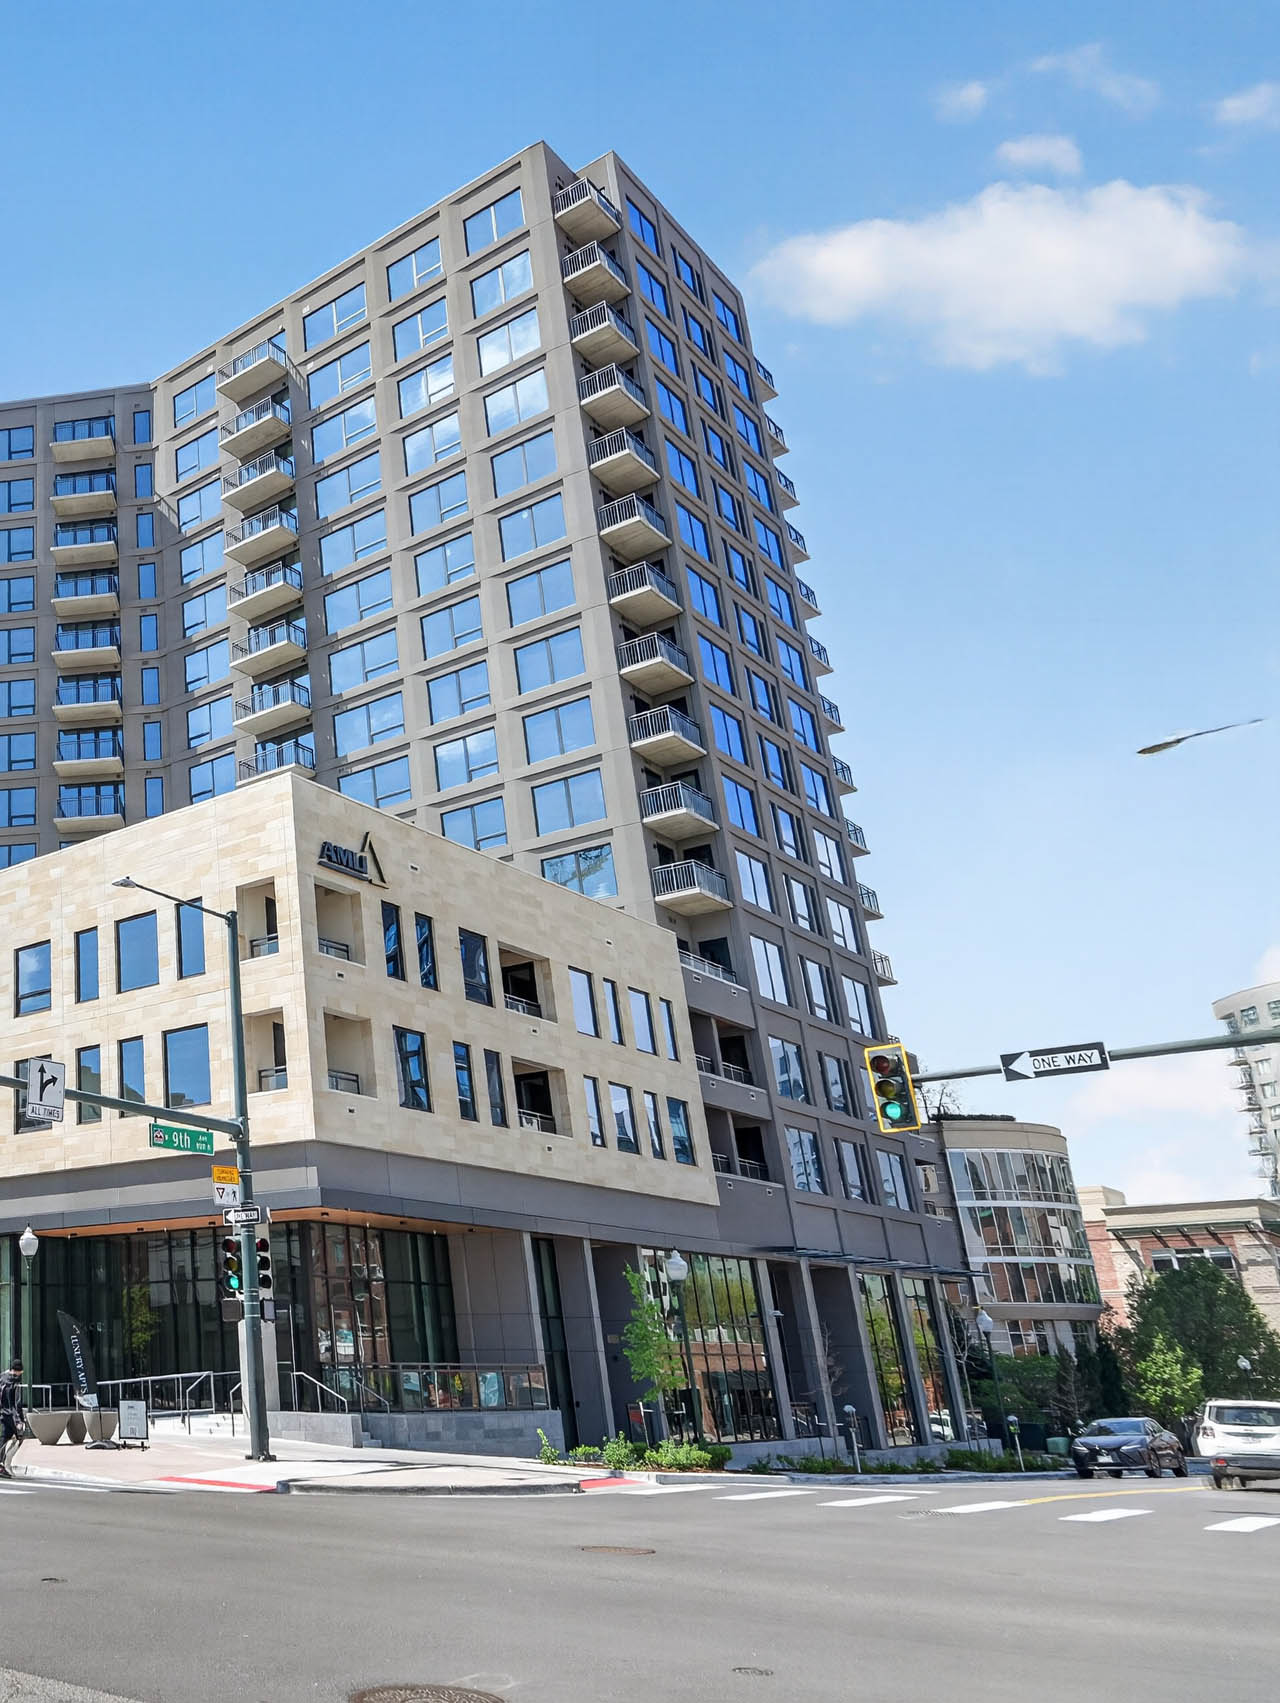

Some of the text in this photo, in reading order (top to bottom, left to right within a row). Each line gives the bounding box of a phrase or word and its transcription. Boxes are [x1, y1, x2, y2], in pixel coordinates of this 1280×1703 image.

[1032, 1051, 1095, 1070] ONE WAY
[31, 1105, 60, 1119] ALL TIMES
[172, 1131, 191, 1149] 9th
[70, 1335, 85, 1369] LUXURY
